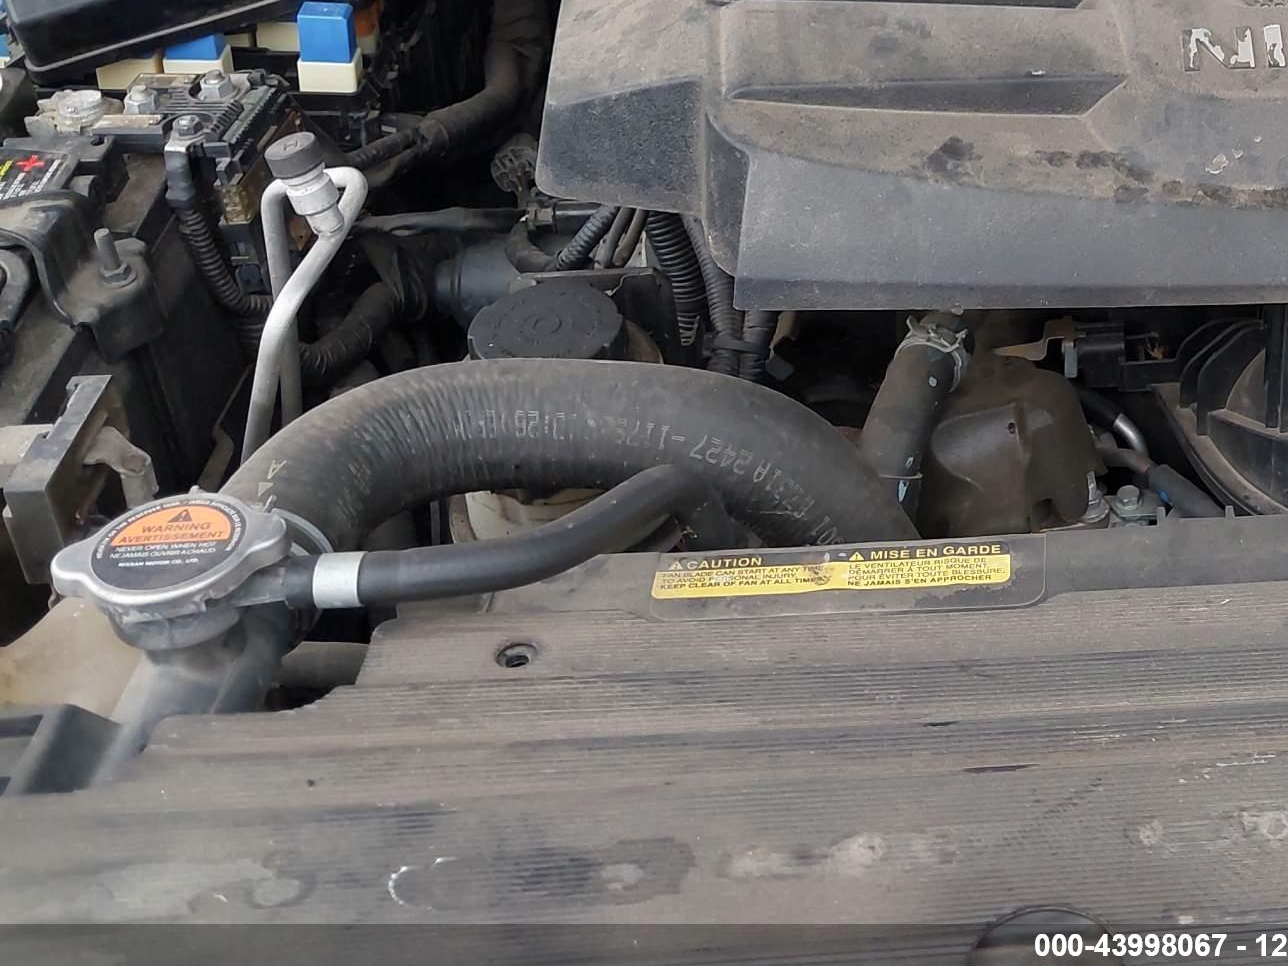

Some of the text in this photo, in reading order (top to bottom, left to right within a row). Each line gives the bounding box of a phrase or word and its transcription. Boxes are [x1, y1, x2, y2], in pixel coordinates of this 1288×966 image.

[142, 521, 211, 533] WARNING
[118, 530, 225, 543] AVERTISSEMENT
[916, 547, 937, 557] EN
[943, 544, 1001, 555] GARDE
[687, 557, 762, 570] CAUTION
[865, 560, 931, 569] VENTILATEUR
[934, 557, 970, 565] RISQUE
[864, 579, 900, 587] JAMAIS
[930, 574, 992, 583] APPROCHER
[917, 570, 949, 578] TOUTE
